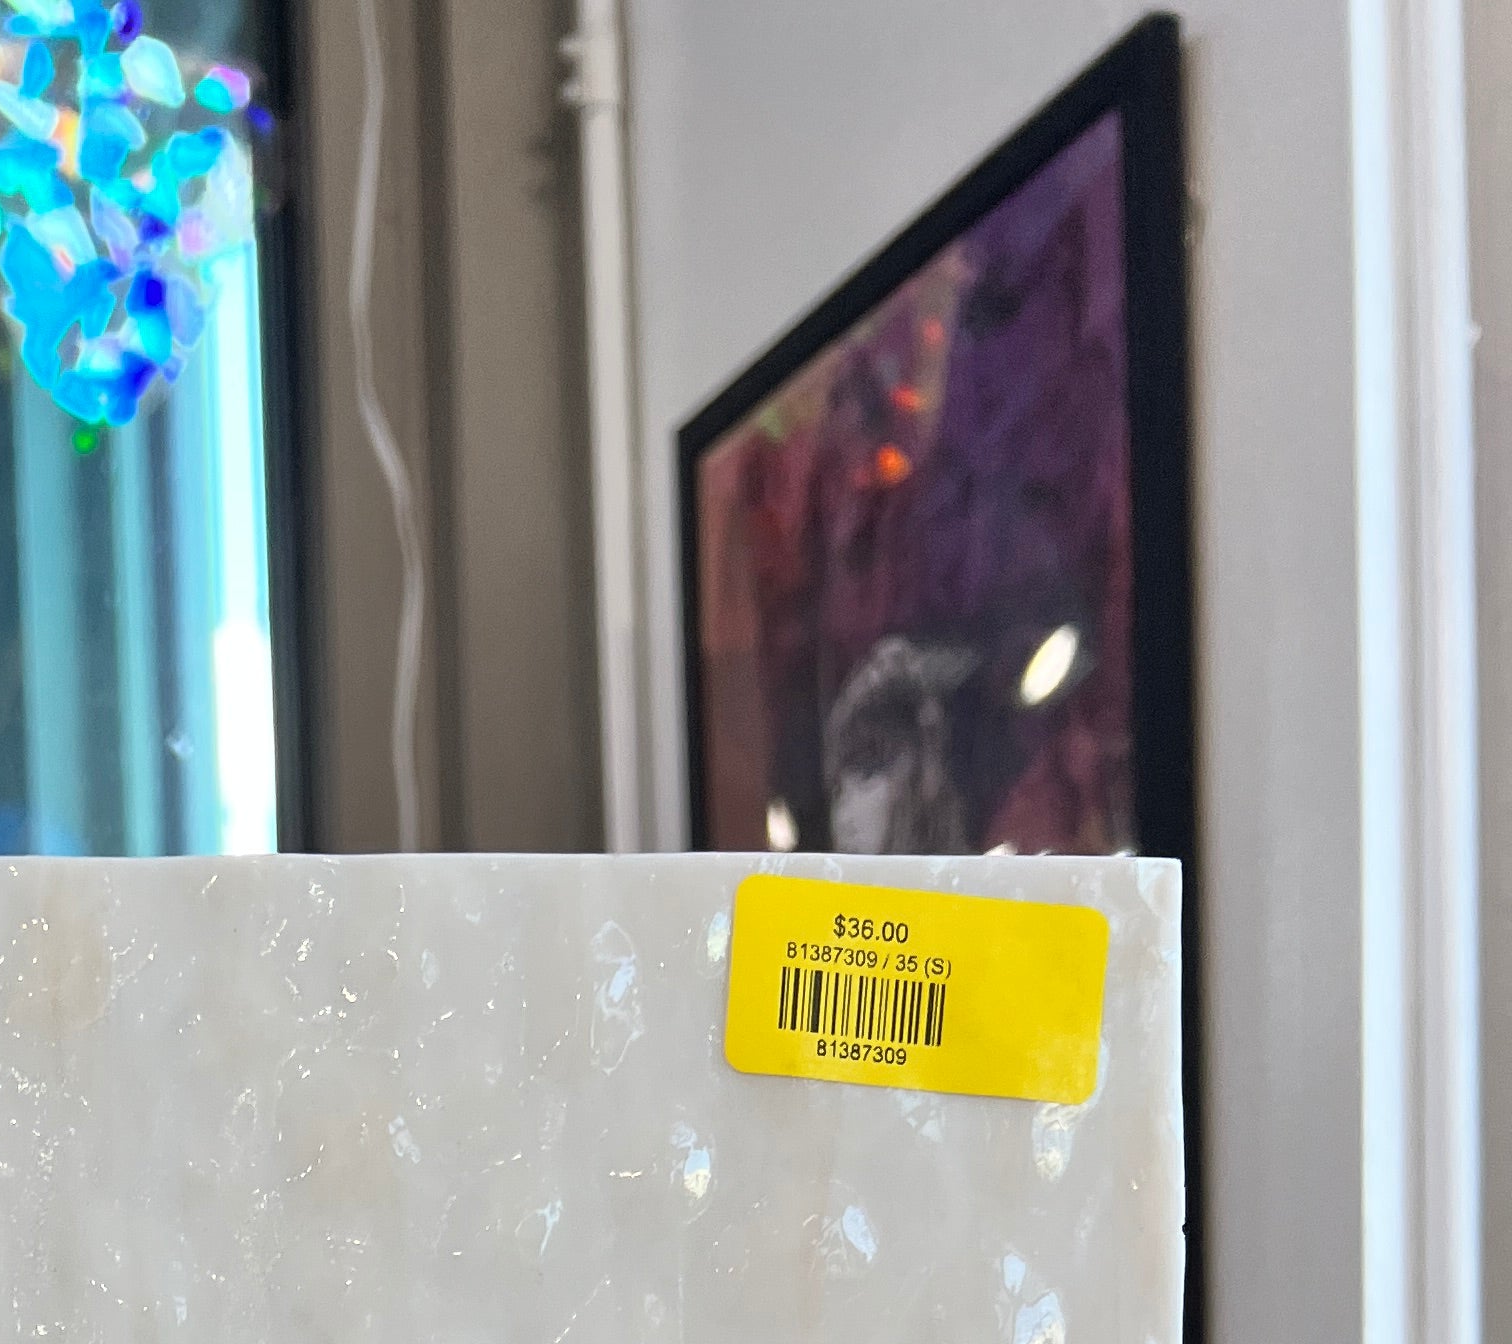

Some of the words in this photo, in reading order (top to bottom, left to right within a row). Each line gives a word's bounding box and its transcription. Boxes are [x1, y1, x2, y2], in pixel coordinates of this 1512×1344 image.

[833, 913, 909, 944] $36.00
[786, 941, 878, 969] 81387309
[882, 954, 889, 970] /
[895, 954, 918, 973] 35
[924, 957, 952, 979] (S)
[816, 1038, 907, 1065] 81387309
